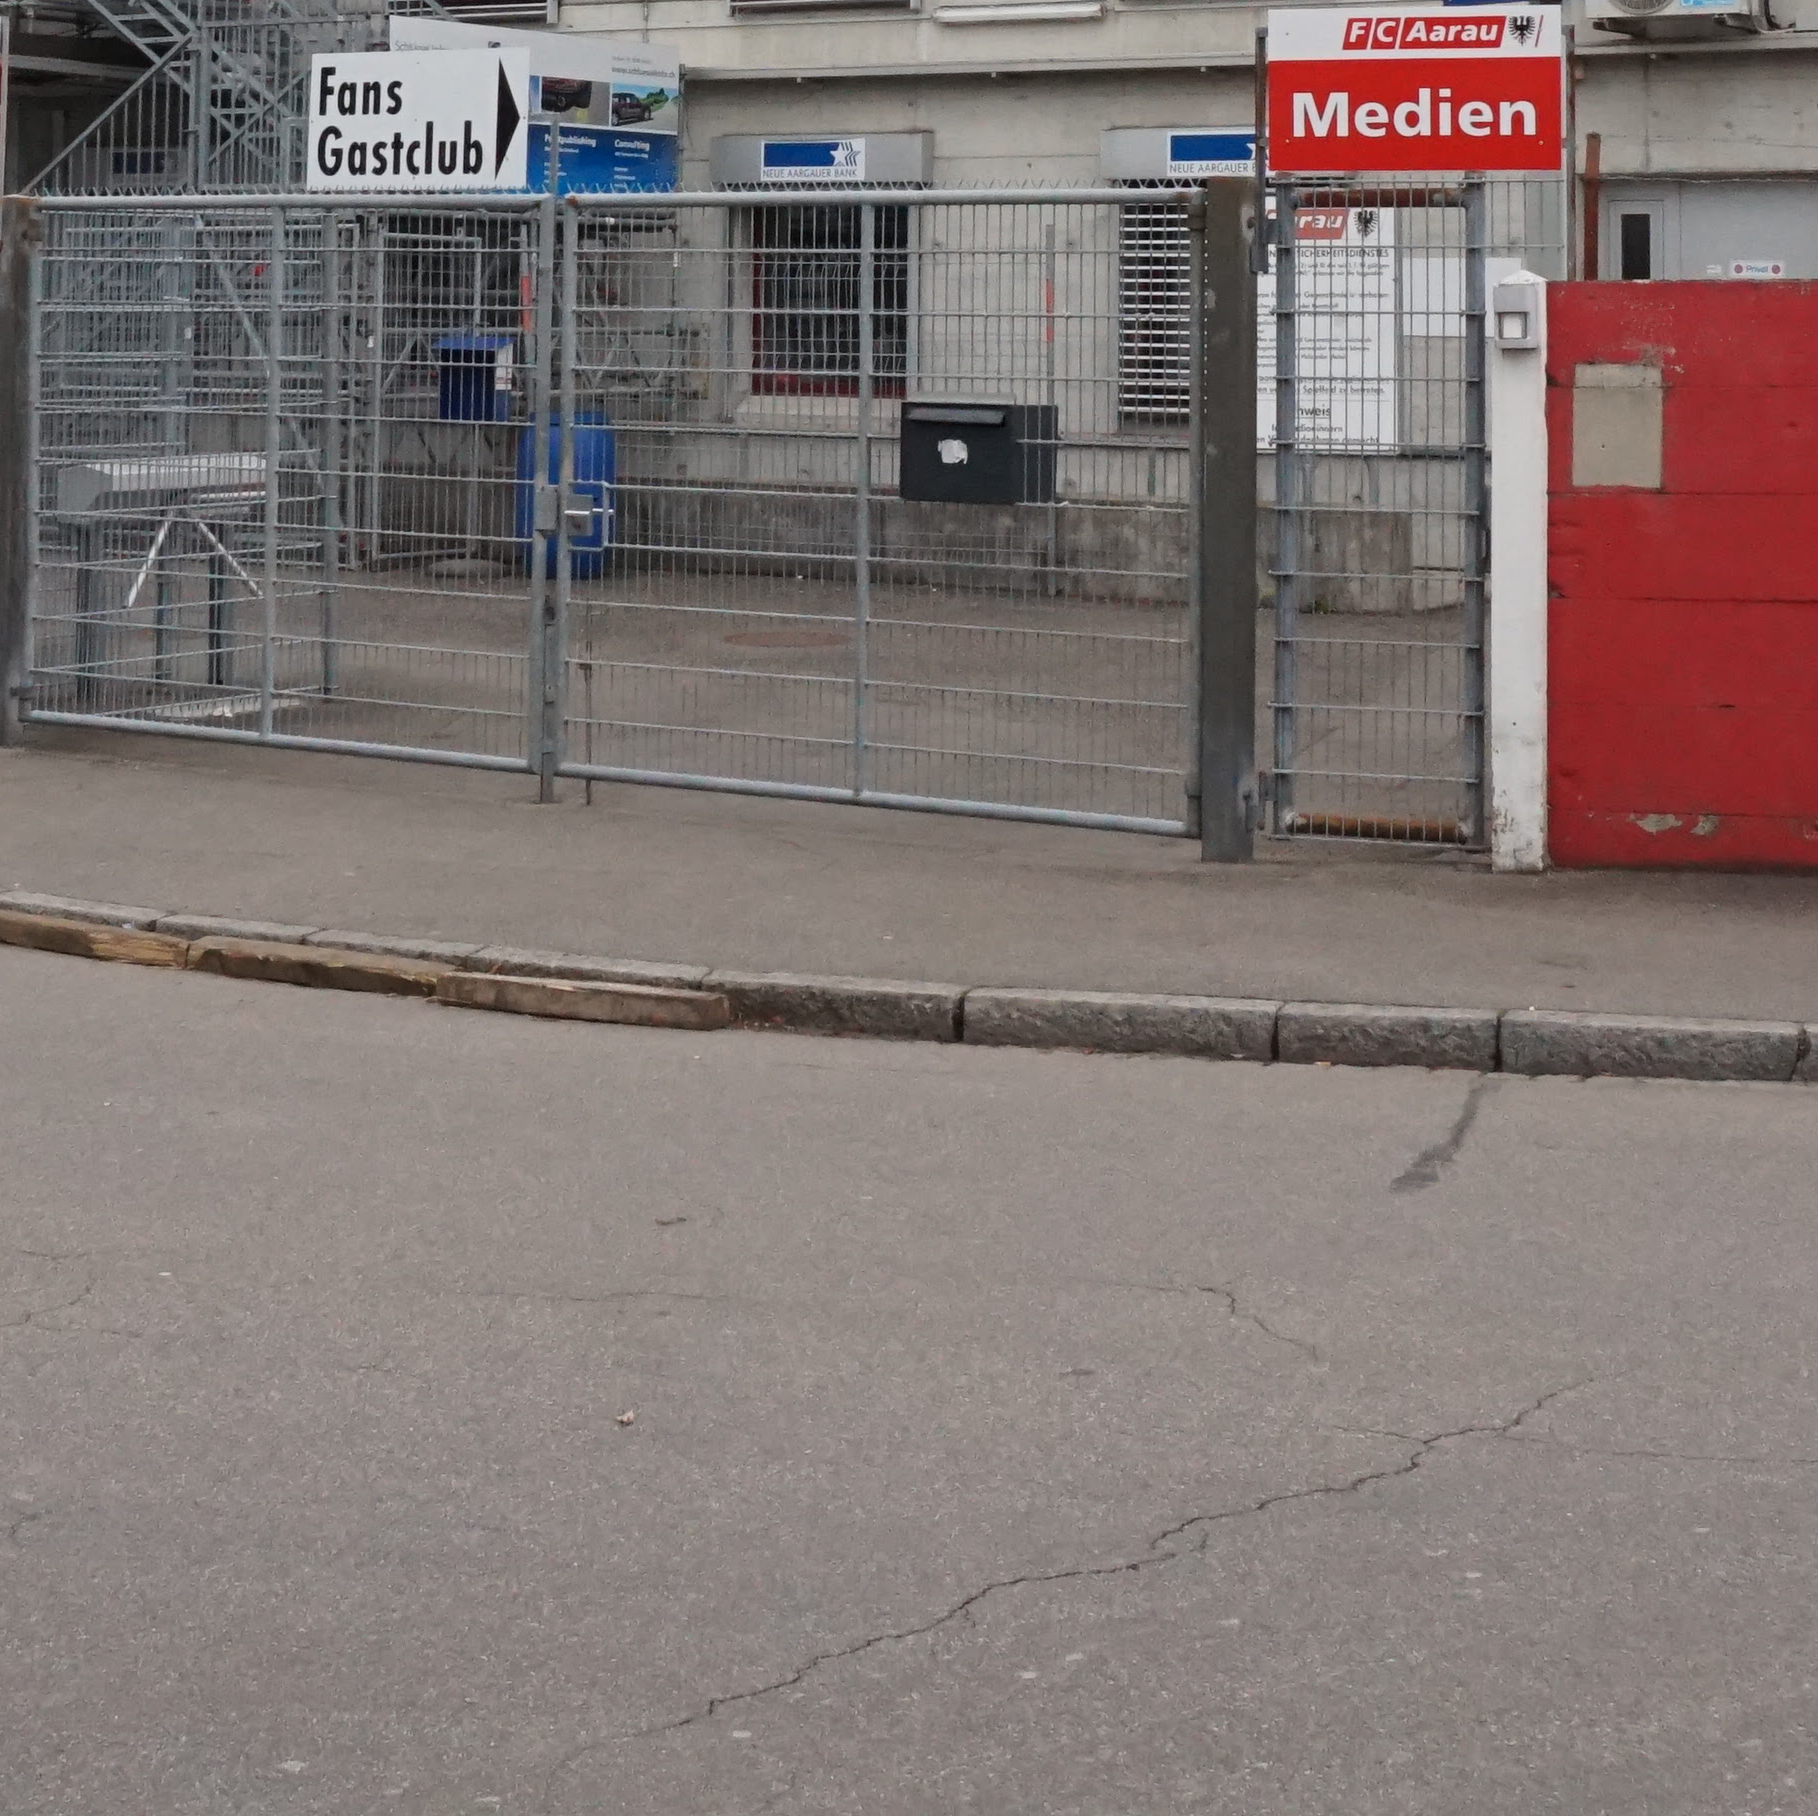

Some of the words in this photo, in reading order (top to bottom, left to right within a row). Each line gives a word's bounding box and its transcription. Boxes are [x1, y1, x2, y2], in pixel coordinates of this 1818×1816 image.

[319, 66, 403, 116] Fans
[1292, 88, 1537, 138] Medien
[317, 120, 483, 176] Gastclub
[1169, 163, 1195, 174] NEUE
[1198, 163, 1249, 174] AARGAUER
[763, 168, 785, 179] NEUE
[786, 169, 832, 178] AARGAUER
[834, 168, 858, 177] BANK
